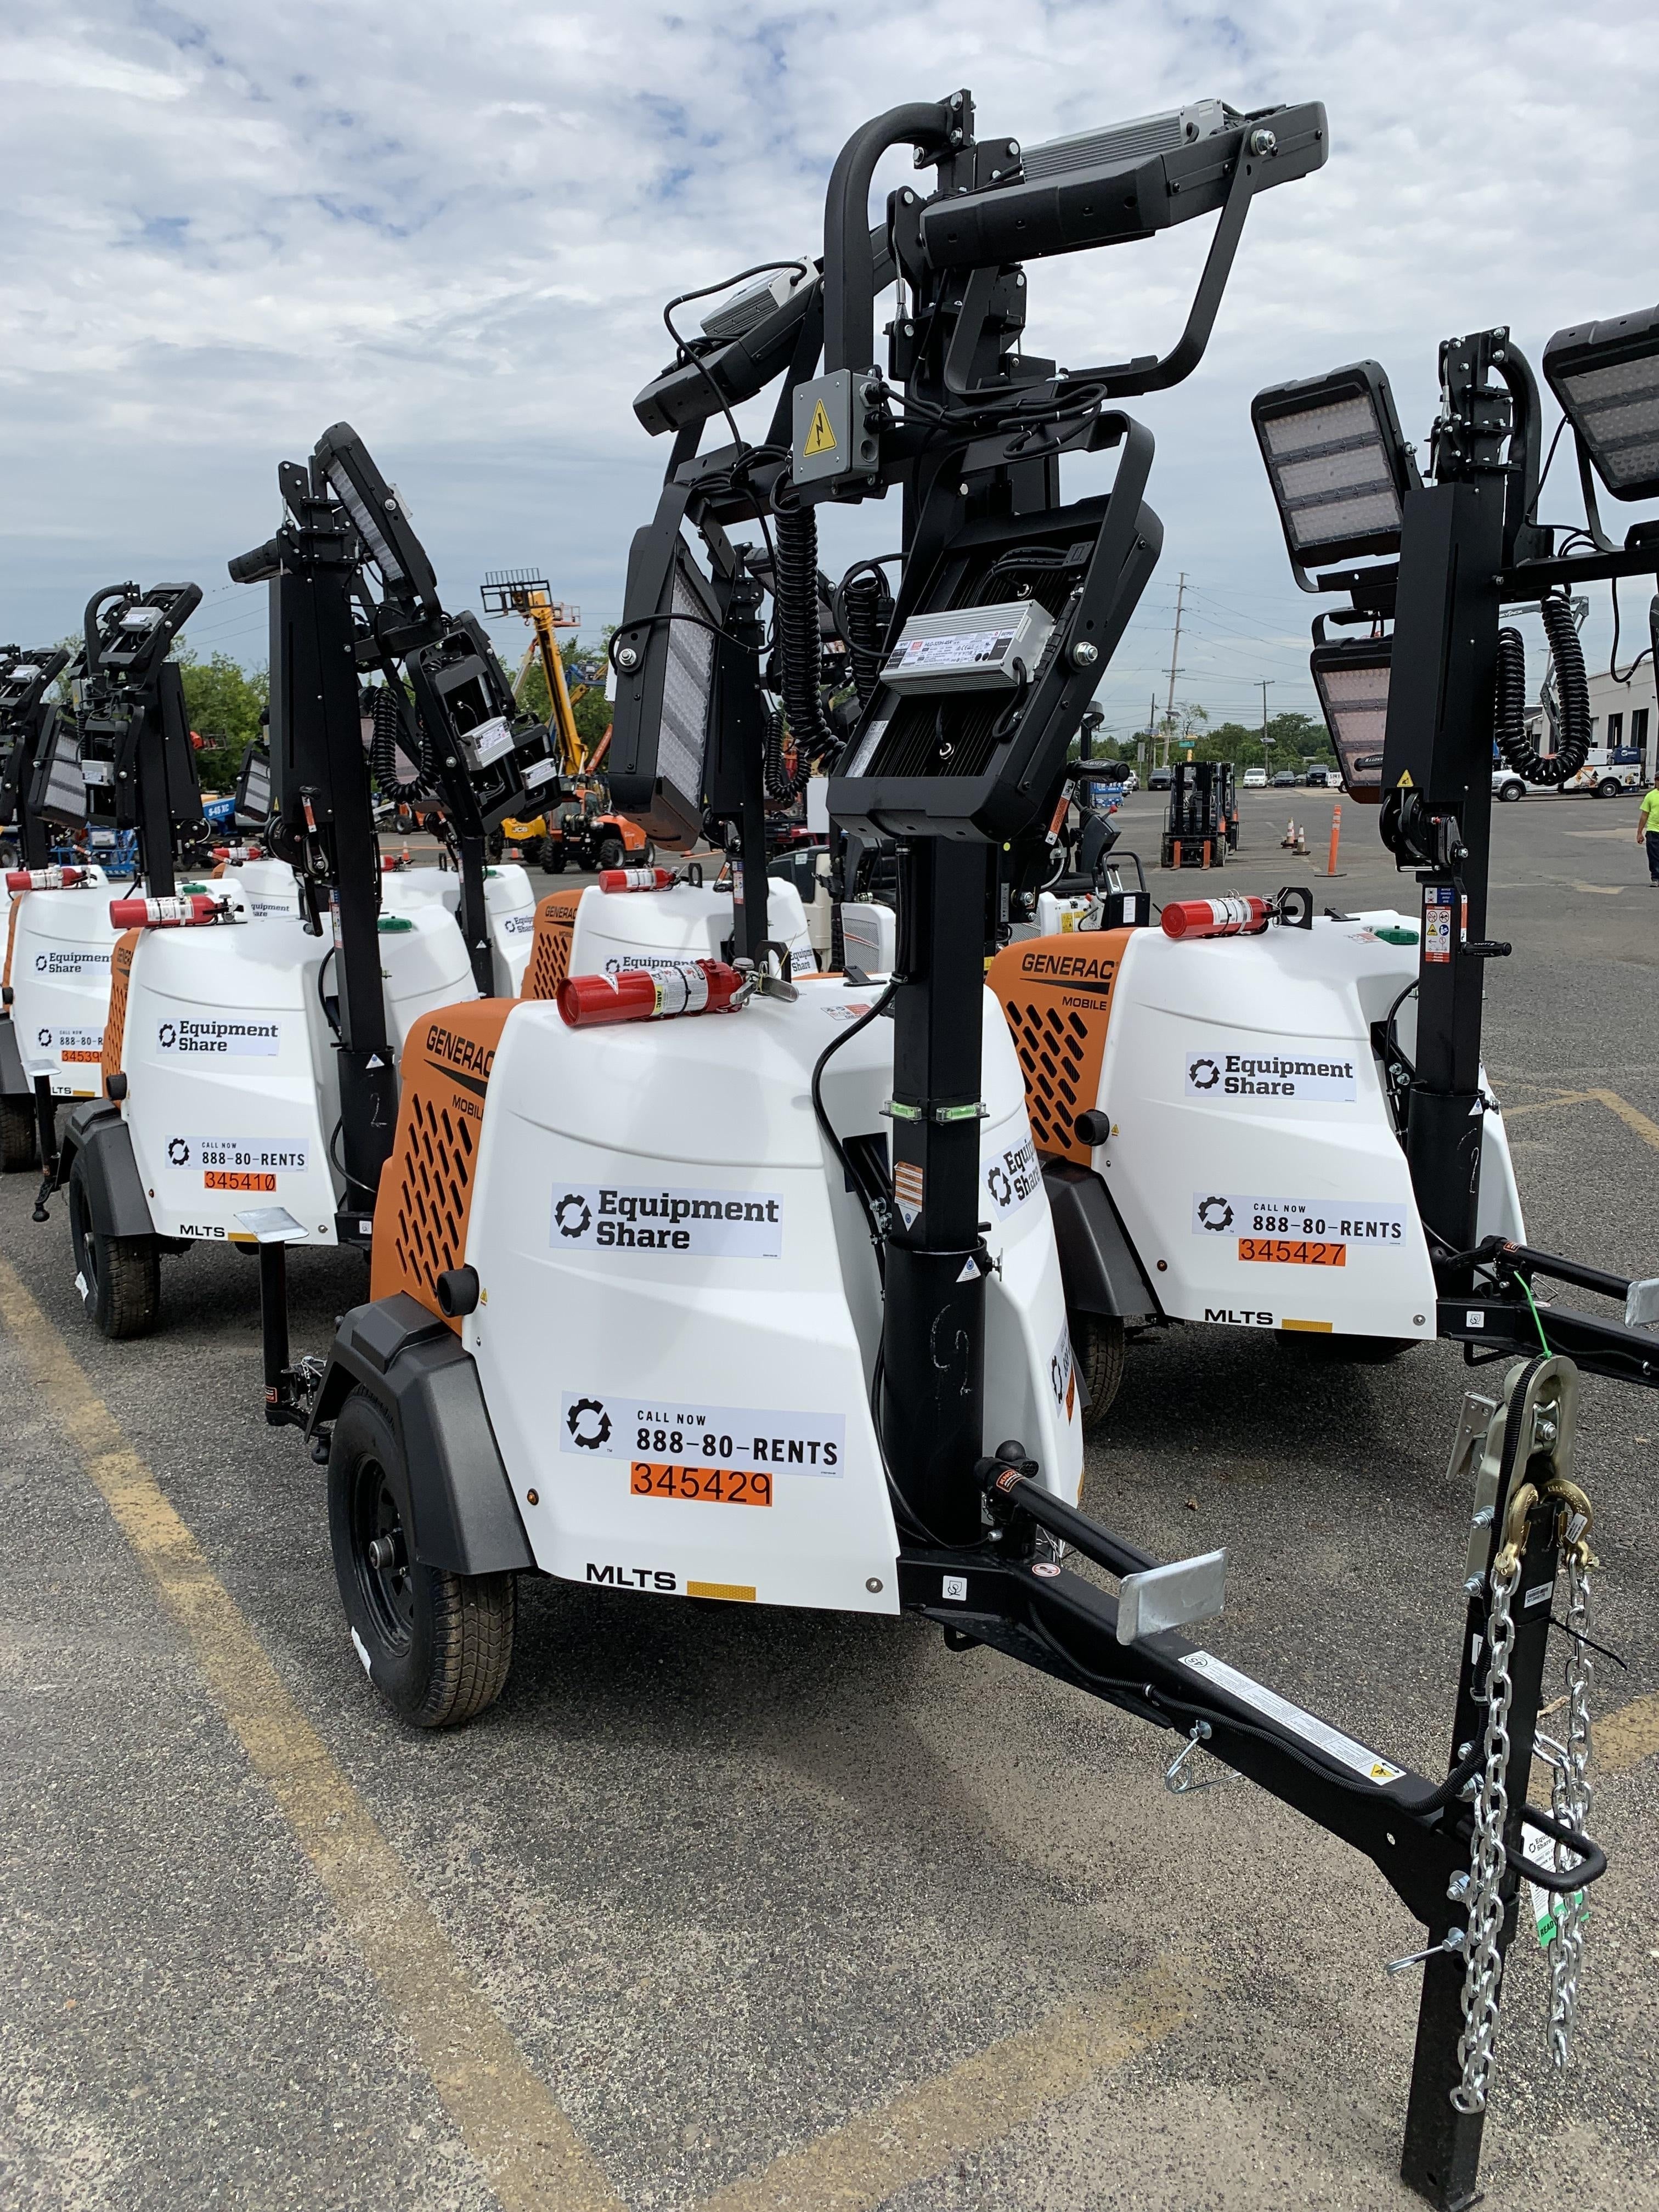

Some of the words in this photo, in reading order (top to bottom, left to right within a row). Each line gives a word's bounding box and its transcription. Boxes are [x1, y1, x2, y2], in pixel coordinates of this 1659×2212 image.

[49, 964, 82, 973] Share
[792, 961, 810, 972] Share
[1022, 953, 1113, 979] GENERAC
[1062, 996, 1107, 1011] MOBILE
[179, 1021, 278, 1037] Equipment
[179, 1039, 228, 1052] Share
[426, 1025, 495, 1078] GENERAC
[1225, 1056, 1353, 1079] Equipment
[1224, 1077, 1295, 1096] Share
[202, 1152, 304, 1166] 888-80-RENTS
[206, 1171, 275, 1190] 345410
[1014, 1166, 1040, 1201] Share
[597, 1189, 779, 1223] Equipment
[1253, 1203, 1279, 1212] CALL
[1283, 1204, 1306, 1213] NOW
[180, 1224, 225, 1238] MLTS
[596, 1221, 690, 1250] Share
[1253, 1215, 1402, 1239] 888-80-RENTS
[1240, 1239, 1345, 1265] 345427
[1205, 1309, 1273, 1325] MLTS
[637, 1410, 669, 1424] CALL
[677, 1413, 706, 1426] NOW
[637, 1428, 838, 1465] 888-80-RENTS
[633, 1463, 770, 1504] 345429
[586, 1564, 676, 1591] MLTS
[1537, 1839, 1552, 1851] Share
